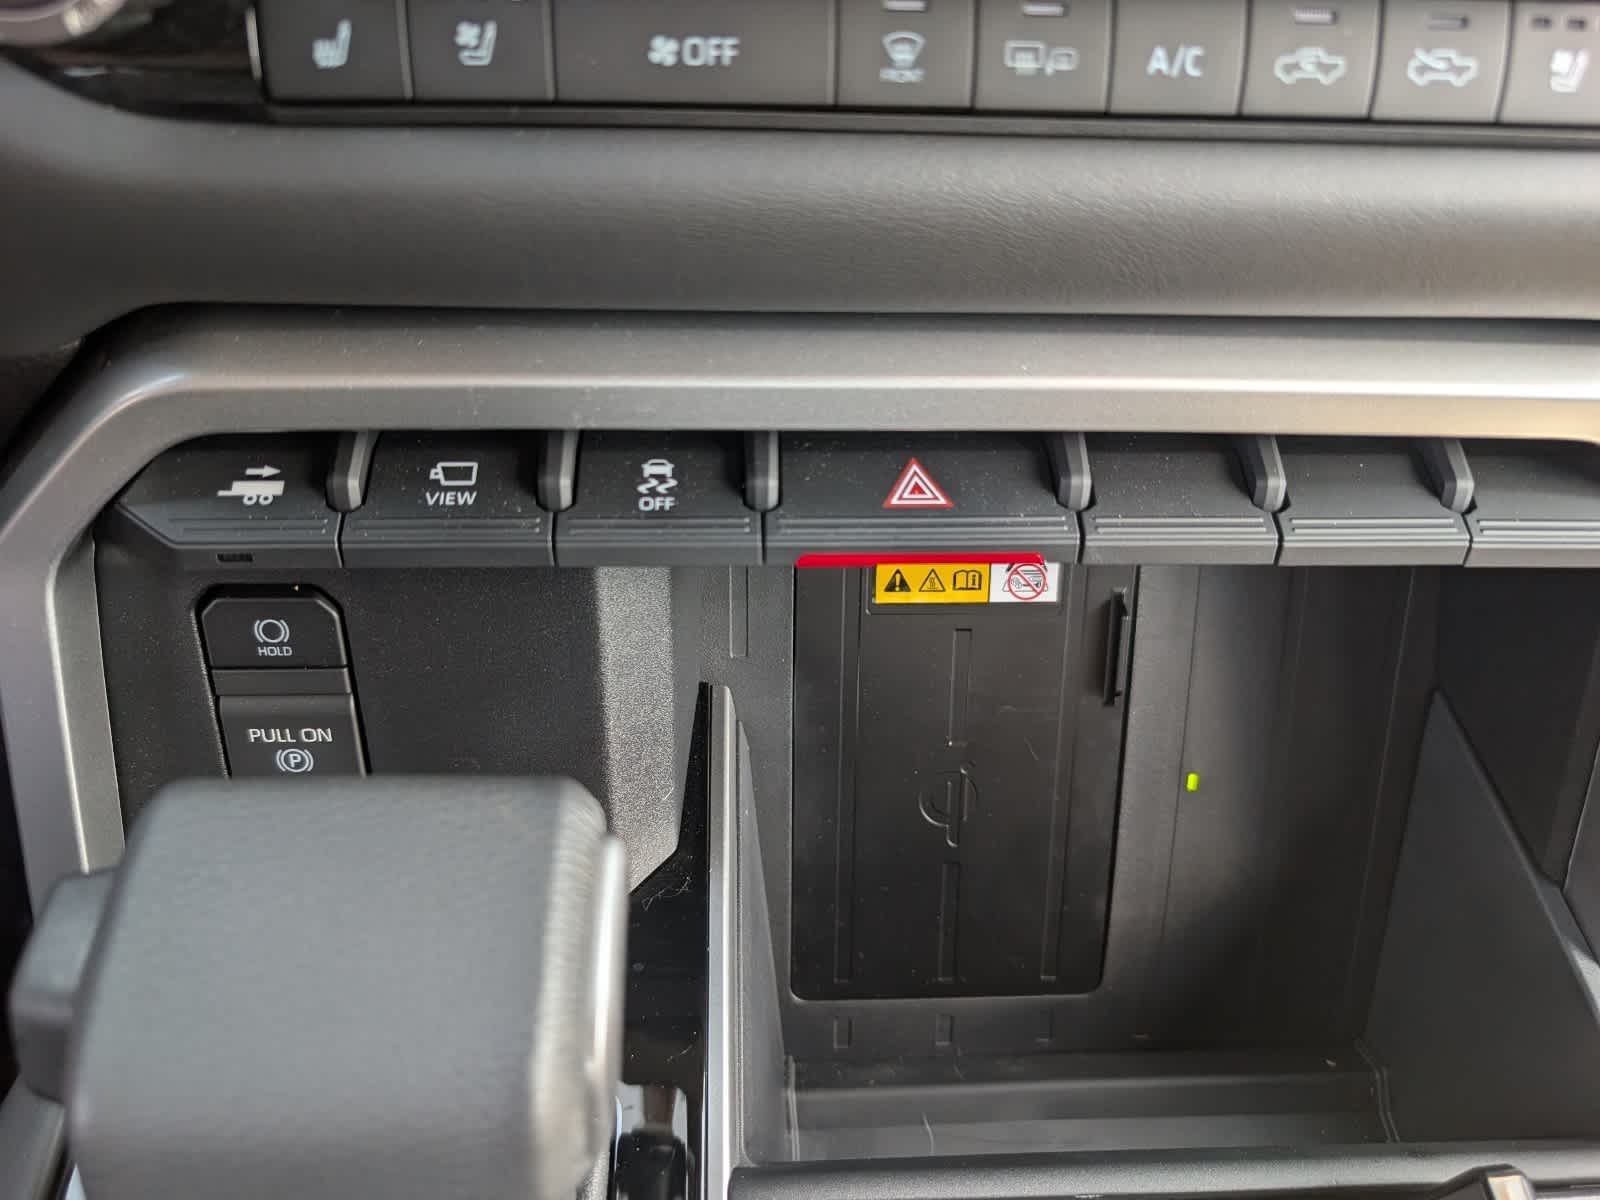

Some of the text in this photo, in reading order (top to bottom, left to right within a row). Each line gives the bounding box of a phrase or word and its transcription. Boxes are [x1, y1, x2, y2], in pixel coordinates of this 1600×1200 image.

[682, 36, 740, 66] OFF
[1147, 44, 1204, 77] A/C
[425, 491, 477, 506] VIEW
[638, 496, 675, 511] OFF
[257, 646, 292, 656] HOLD
[247, 728, 332, 742] PULL ON
